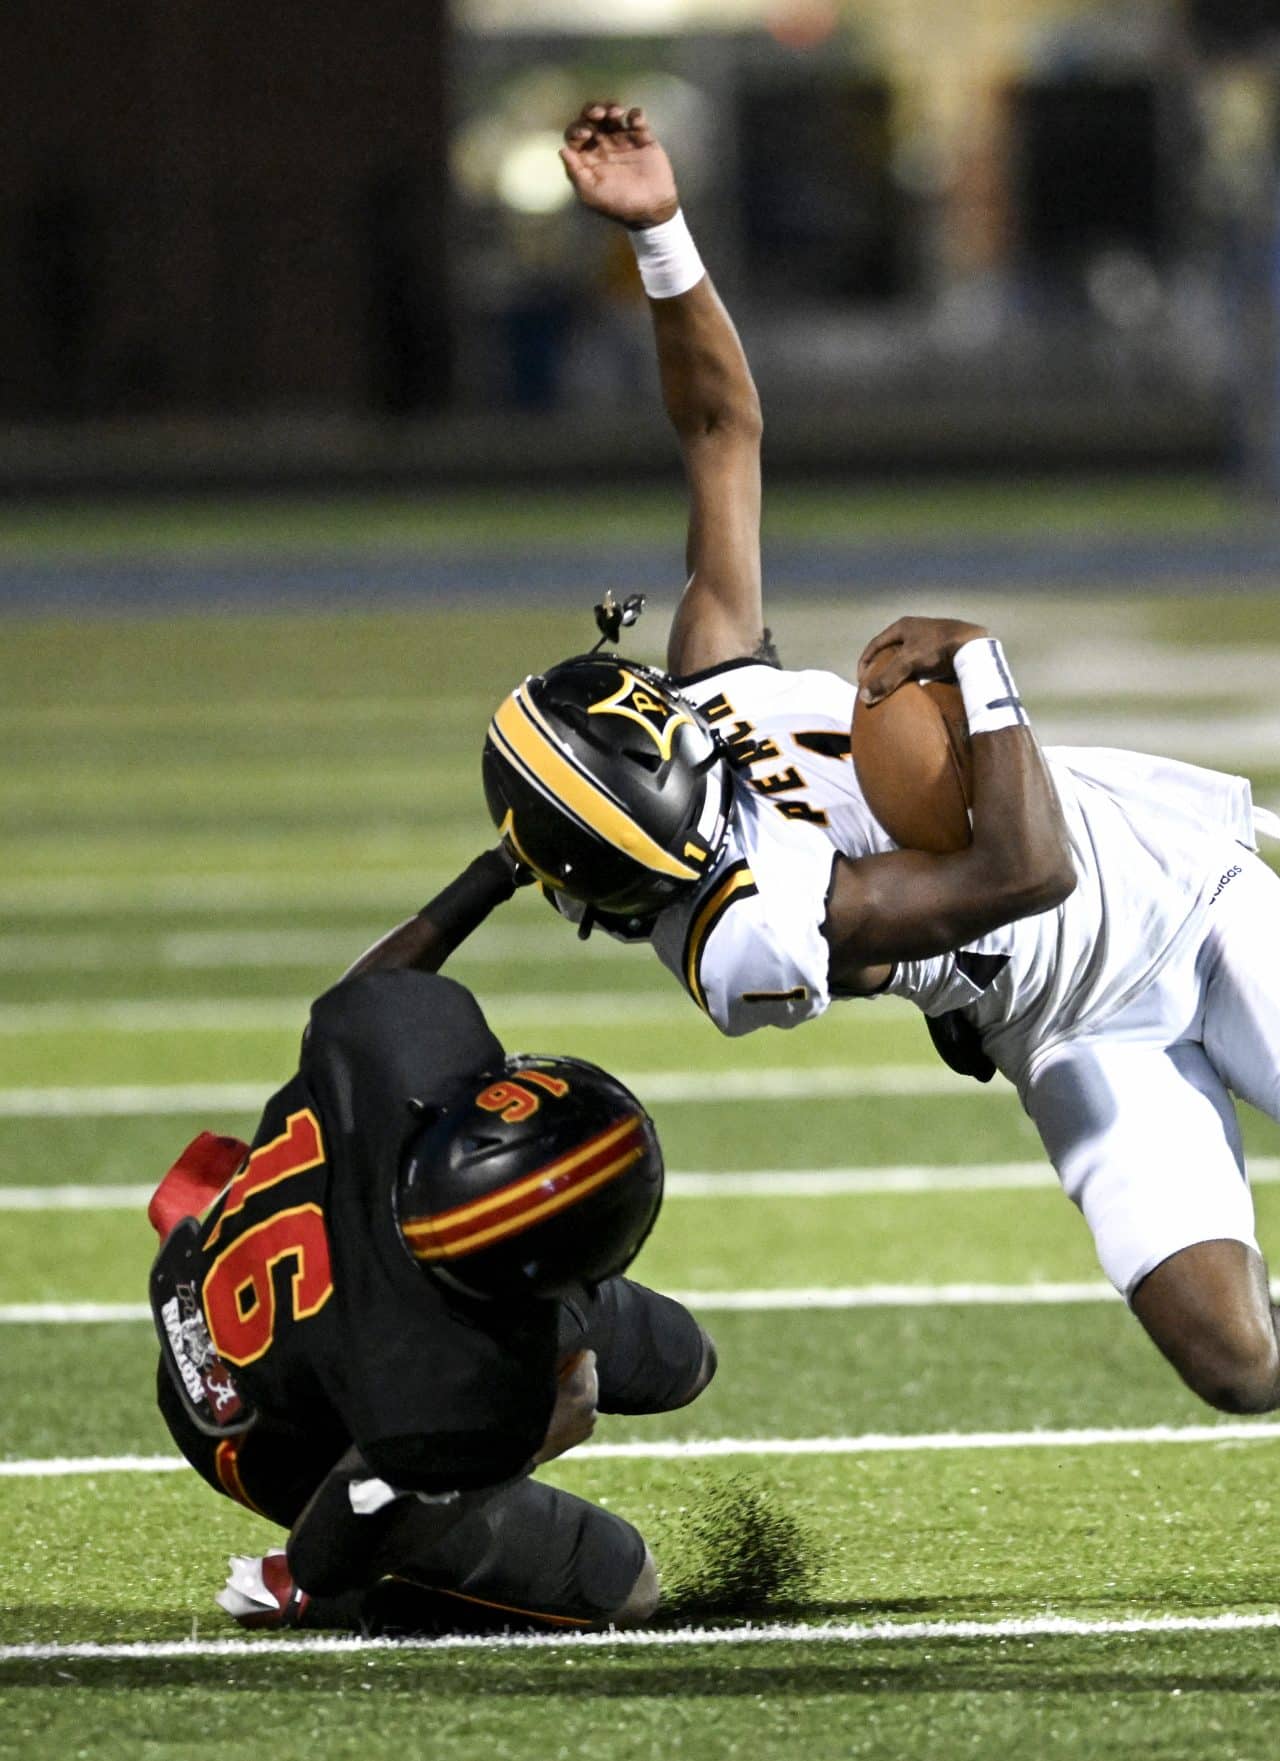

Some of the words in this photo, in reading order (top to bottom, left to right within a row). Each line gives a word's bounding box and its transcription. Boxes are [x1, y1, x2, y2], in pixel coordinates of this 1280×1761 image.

[684, 841, 707, 862] 1
[475, 1070, 569, 1123] 16
[202, 1107, 333, 1367] 16
